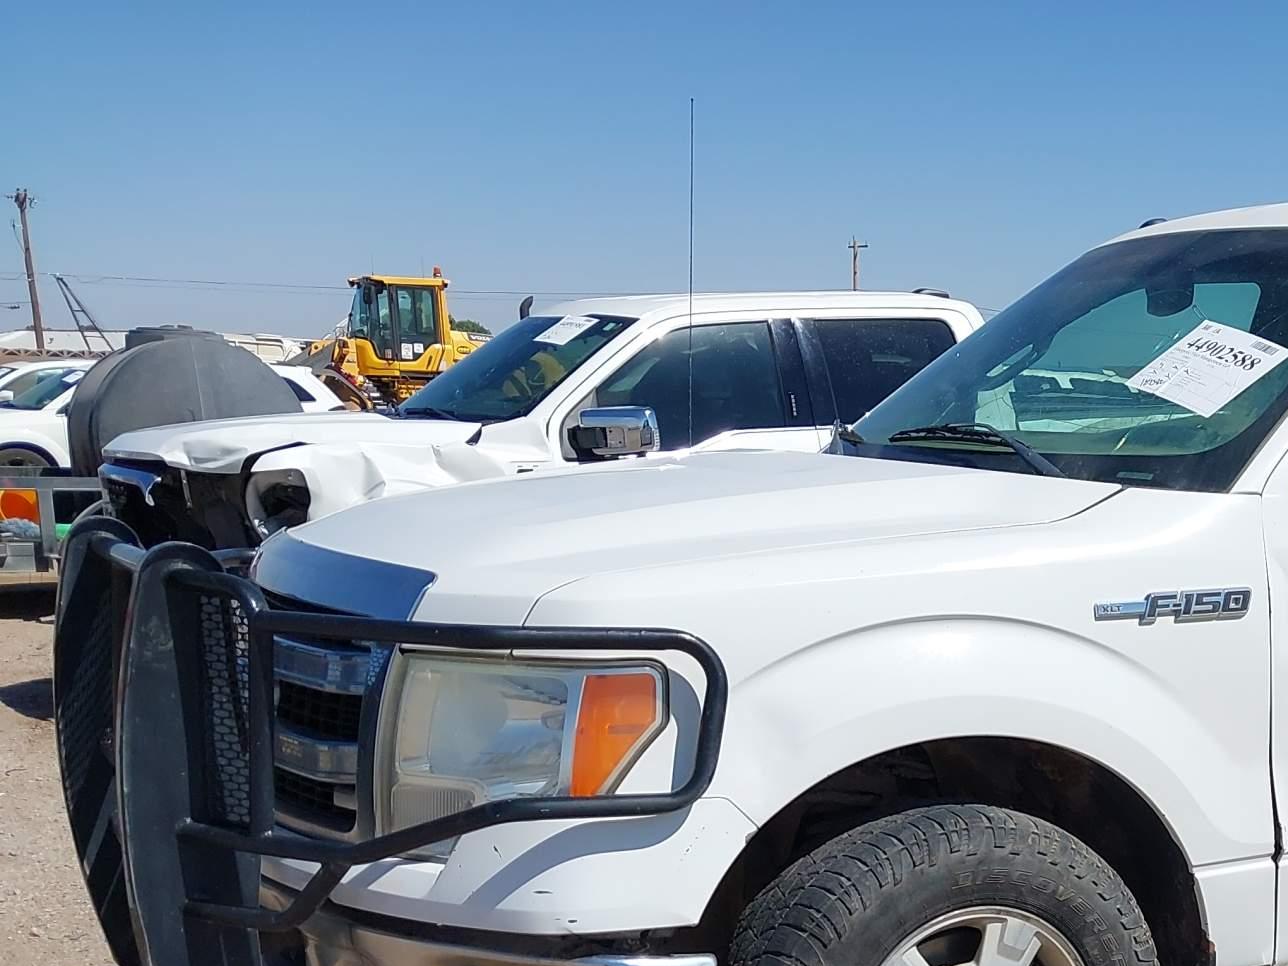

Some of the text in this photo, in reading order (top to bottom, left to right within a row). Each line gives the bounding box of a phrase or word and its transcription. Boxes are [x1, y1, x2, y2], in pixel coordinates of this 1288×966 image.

[1187, 337, 1261, 371] 44902588
[1102, 587, 1251, 626] XLT F-150
